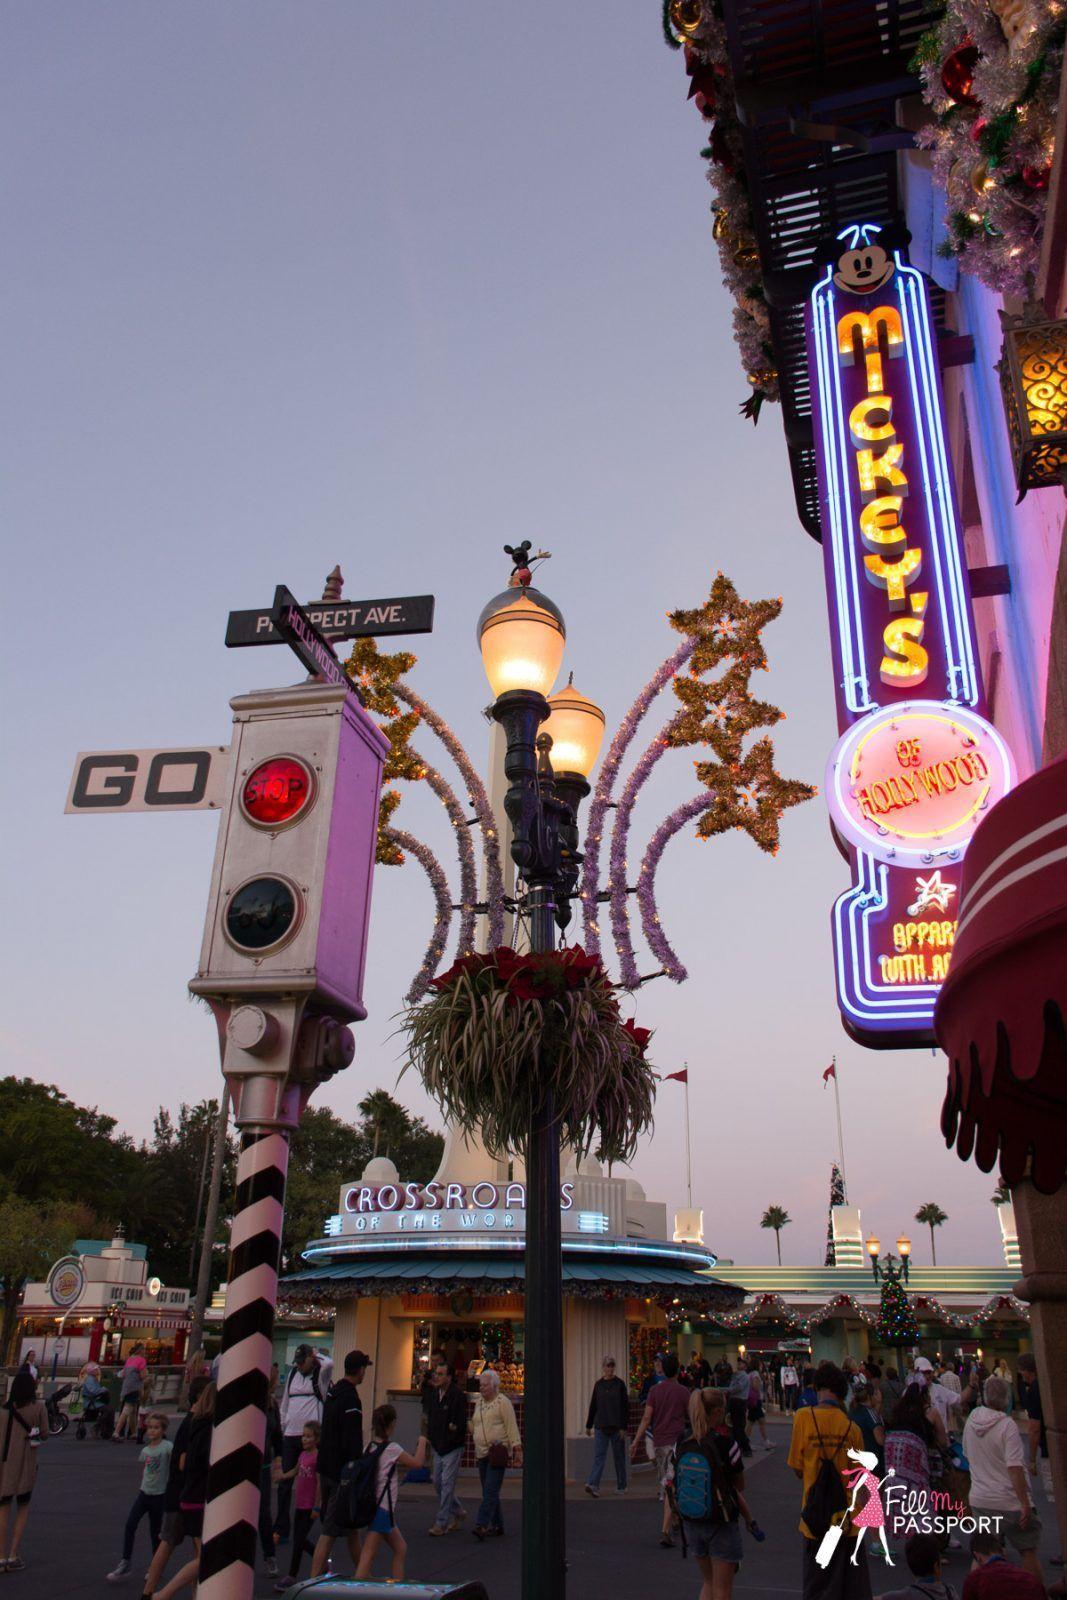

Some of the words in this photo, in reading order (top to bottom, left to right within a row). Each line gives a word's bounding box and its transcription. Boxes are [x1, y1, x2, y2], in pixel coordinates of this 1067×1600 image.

[257, 606, 361, 633] PPECT
[365, 605, 406, 625] AVE.
[289, 606, 340, 684] HOLLYWOOD
[897, 737, 921, 765] OF
[72, 751, 212, 808] GO
[245, 776, 303, 804] STOP
[856, 751, 988, 818] HOLLYWOOD
[893, 921, 958, 949] APPAR
[882, 954, 926, 983] WITH
[344, 1183, 574, 1213] CROSSROAS
[356, 1217, 381, 1231] OF
[398, 1213, 442, 1229] THE
[460, 1213, 520, 1228] WOR
